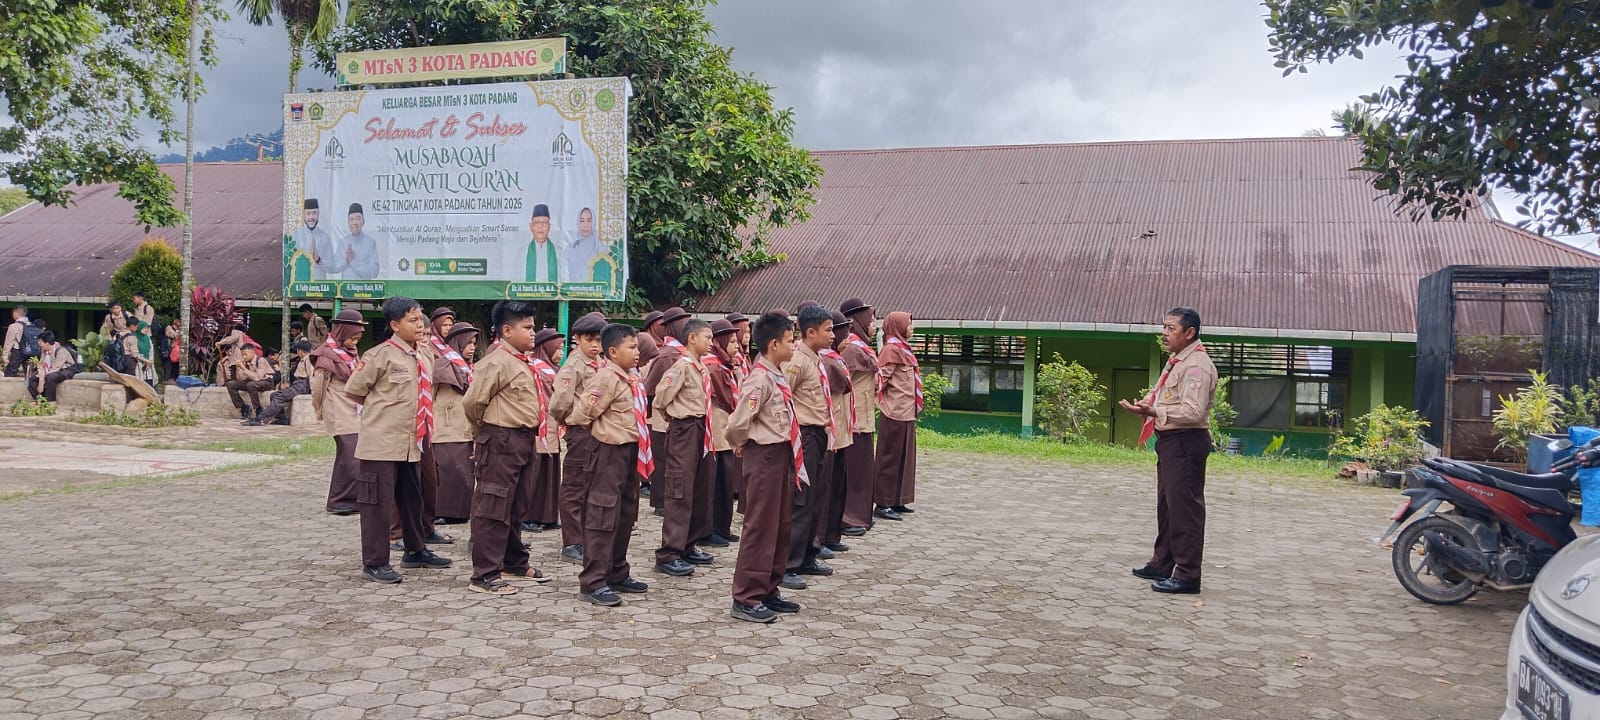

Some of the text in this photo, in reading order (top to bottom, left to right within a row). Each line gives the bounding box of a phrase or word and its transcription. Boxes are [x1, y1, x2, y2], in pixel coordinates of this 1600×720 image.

[364, 49, 537, 76] MTsN 3 KOTA PADANG
[382, 92, 518, 110] KELUARGA BESAR MTsN 3 KOTA PADANG
[363, 111, 529, 144] Selamat & Sukses
[394, 143, 497, 169] MUSABAQAH
[373, 168, 525, 195] TILAWATIL QUR'AN
[371, 197, 523, 212] KE 42 TINGKAT KOTA PADANG TAHUN 2026
[1519, 662, 1531, 694] BA
